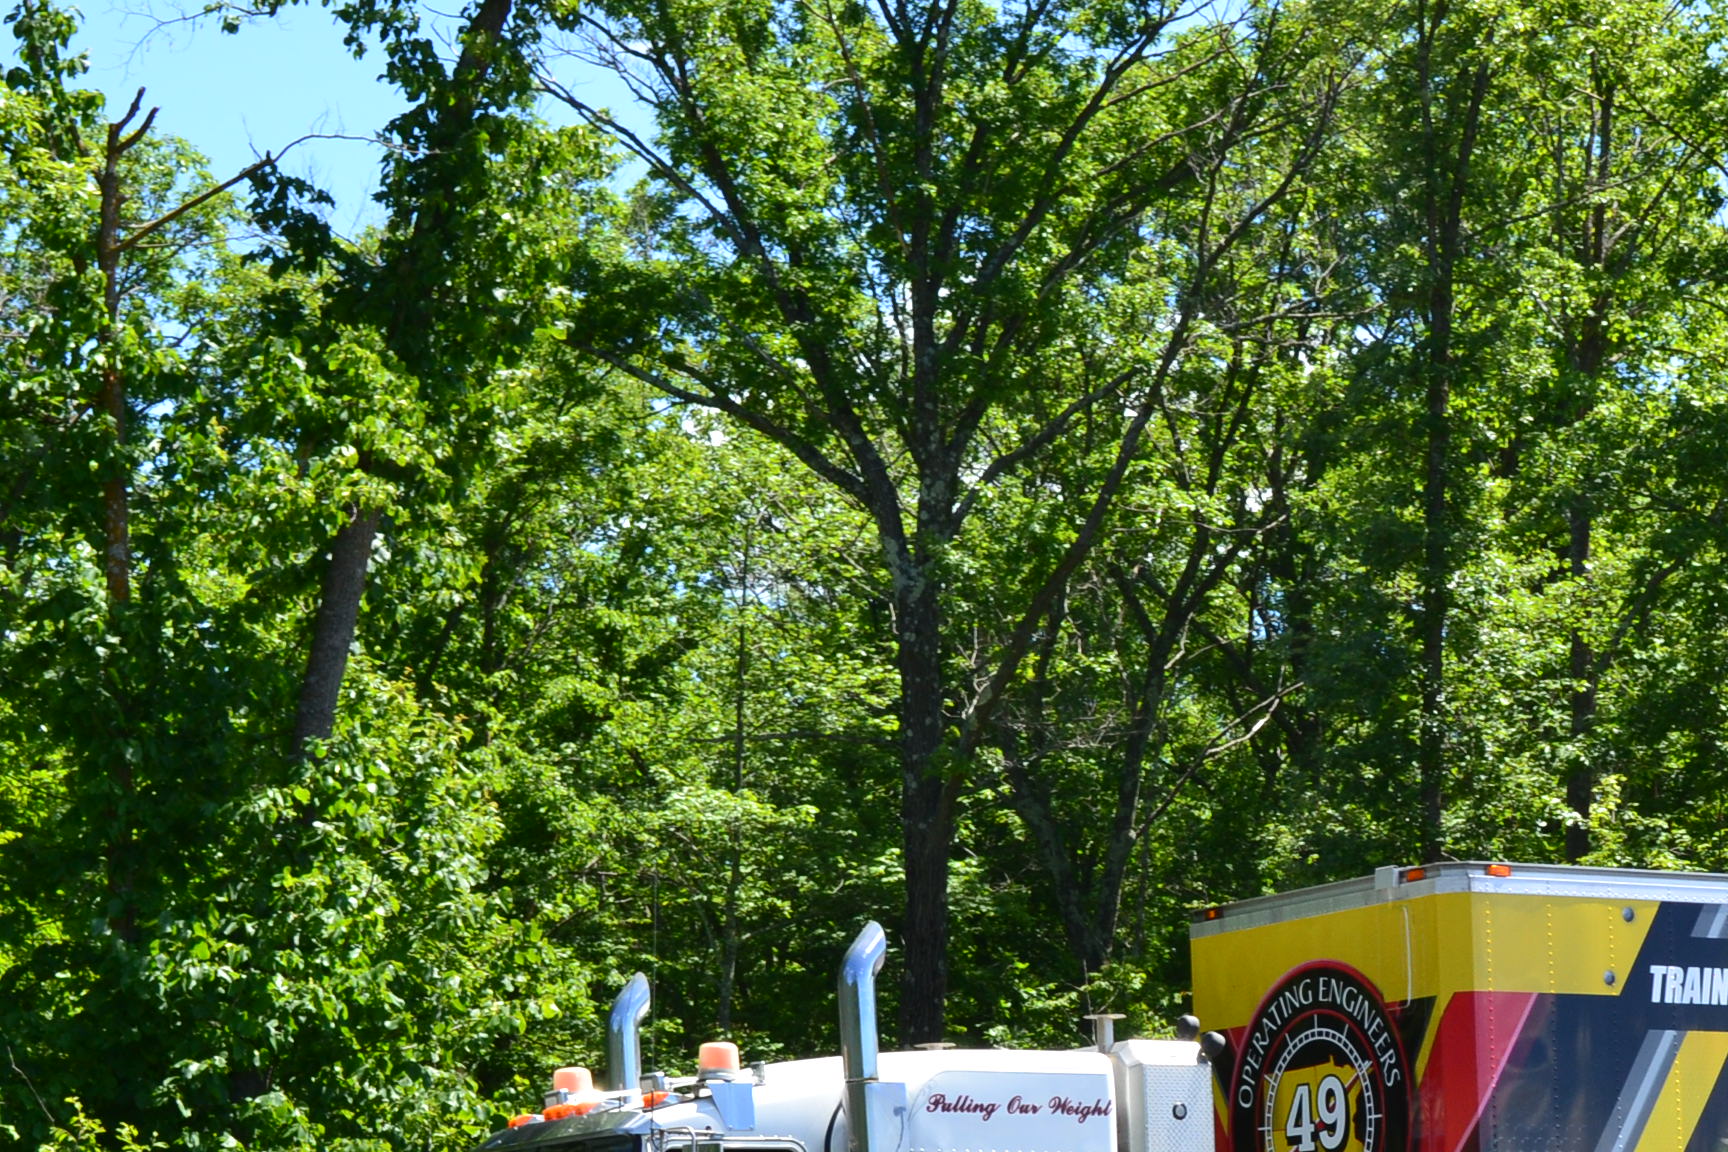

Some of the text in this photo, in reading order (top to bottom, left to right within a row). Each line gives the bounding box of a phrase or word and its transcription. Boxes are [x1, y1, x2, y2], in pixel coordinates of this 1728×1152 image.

[1238, 976, 1401, 1109] OPERATING ENGINEERS
[926, 1093, 1113, 1124] Pulling Our Weight
[1285, 1074, 1347, 1152] 49
